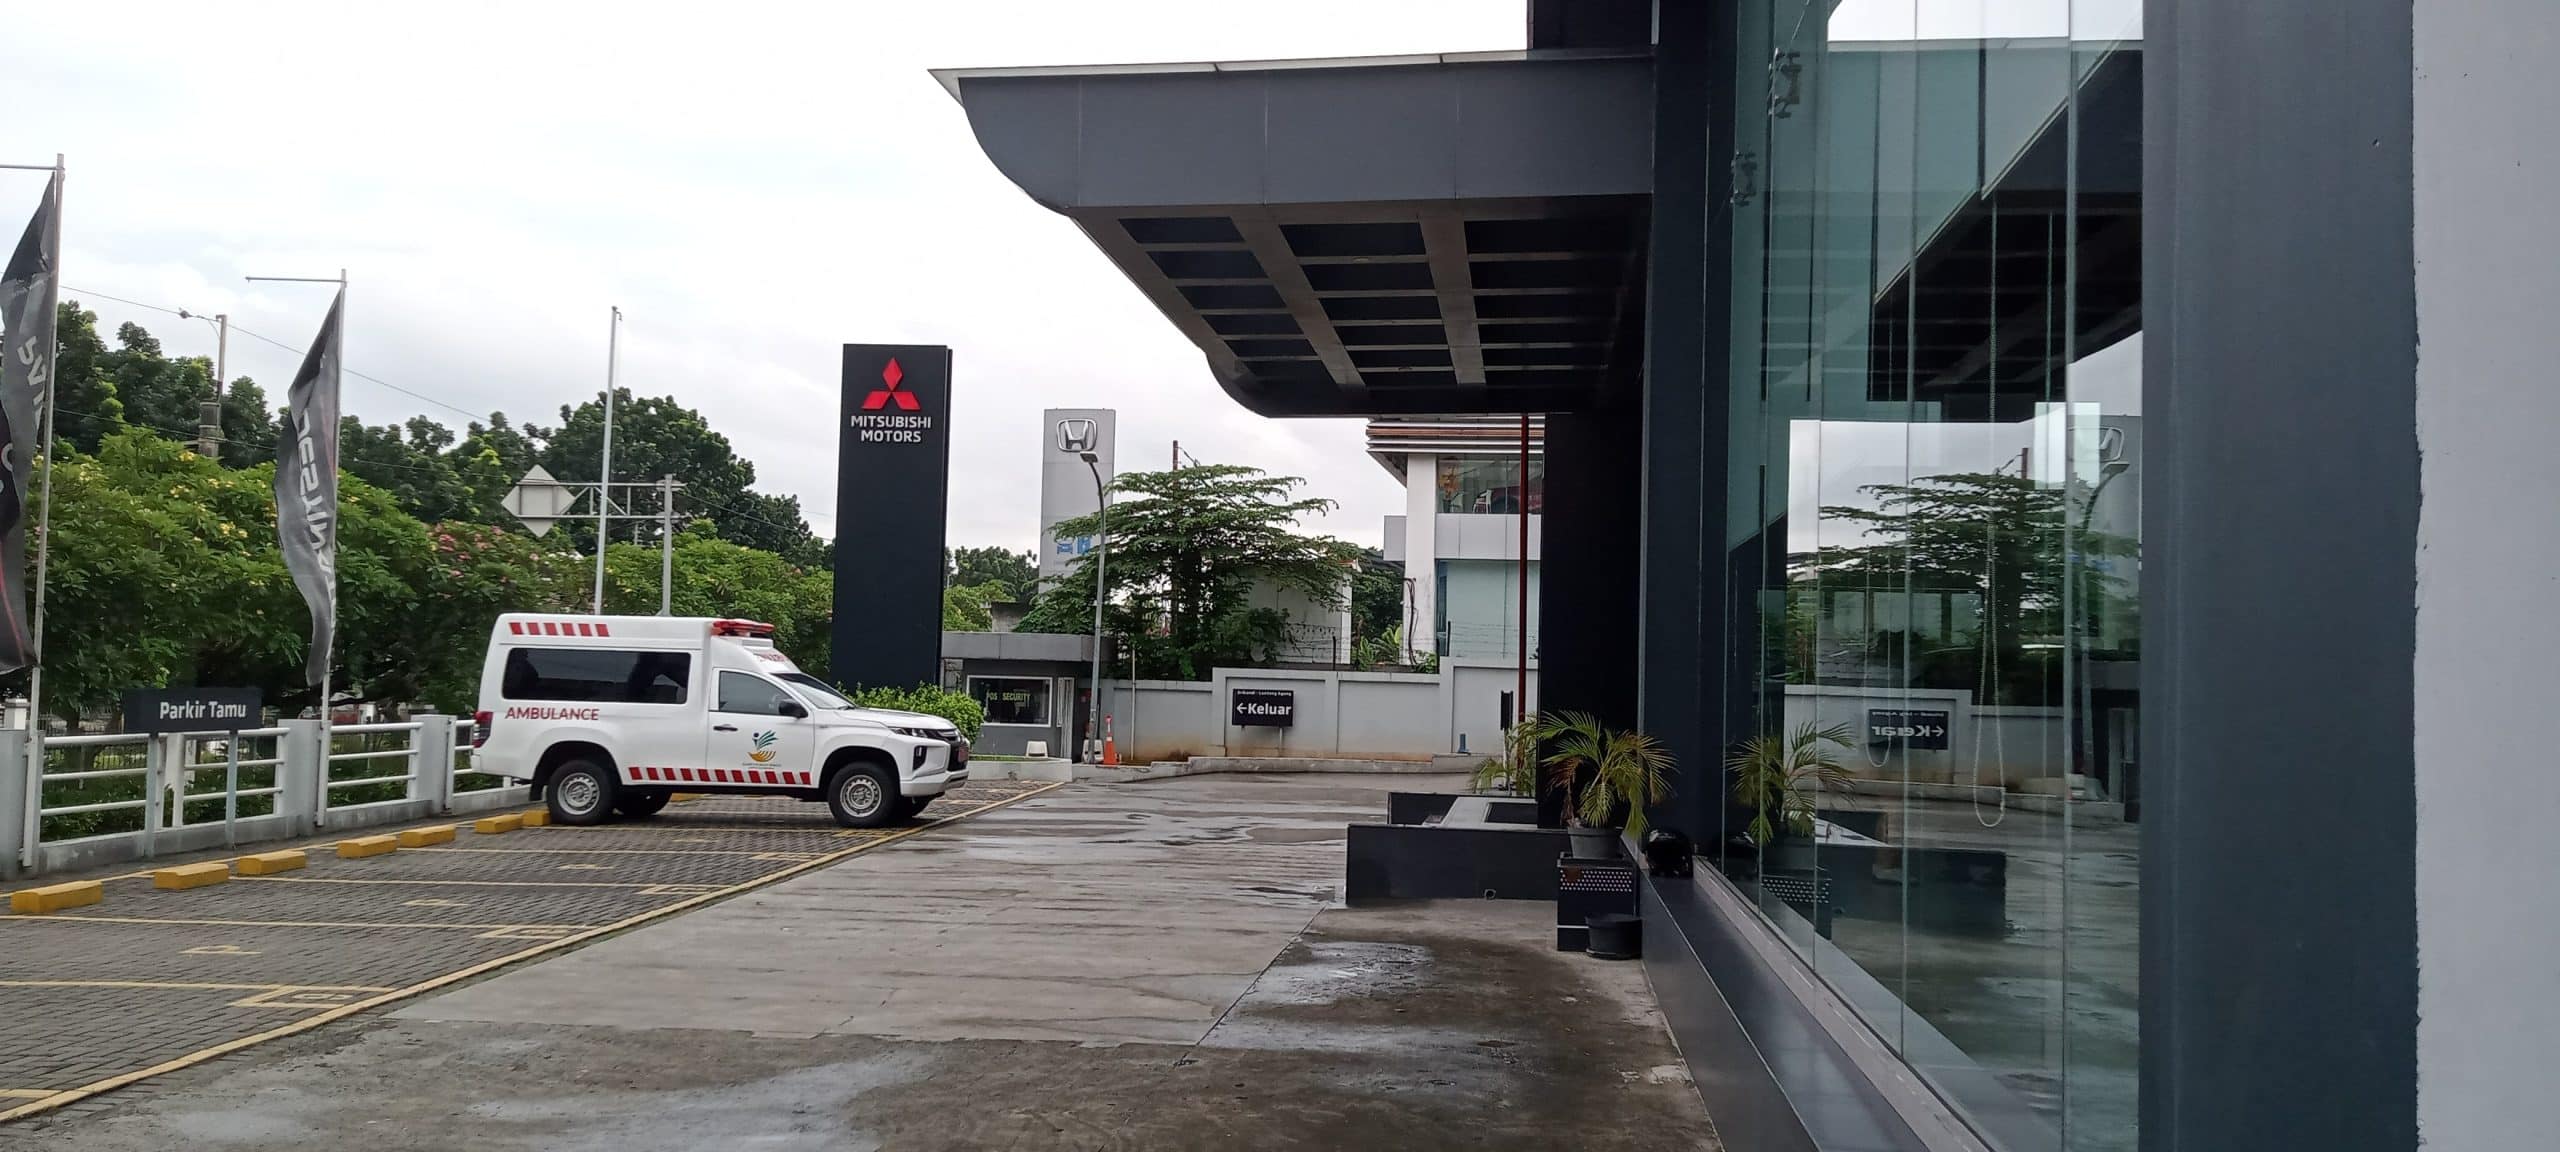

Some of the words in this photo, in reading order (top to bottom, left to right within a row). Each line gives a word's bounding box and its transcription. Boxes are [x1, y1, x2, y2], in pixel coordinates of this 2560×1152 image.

[850, 415, 932, 429] MITSUBISHI
[861, 430, 922, 443] MOTORS
[1002, 692, 1031, 702] SECURITY
[160, 700, 206, 720] Parkir
[208, 701, 246, 719] Tamu
[505, 706, 600, 721] AMBULANCE
[1248, 702, 1292, 715] Keluar
